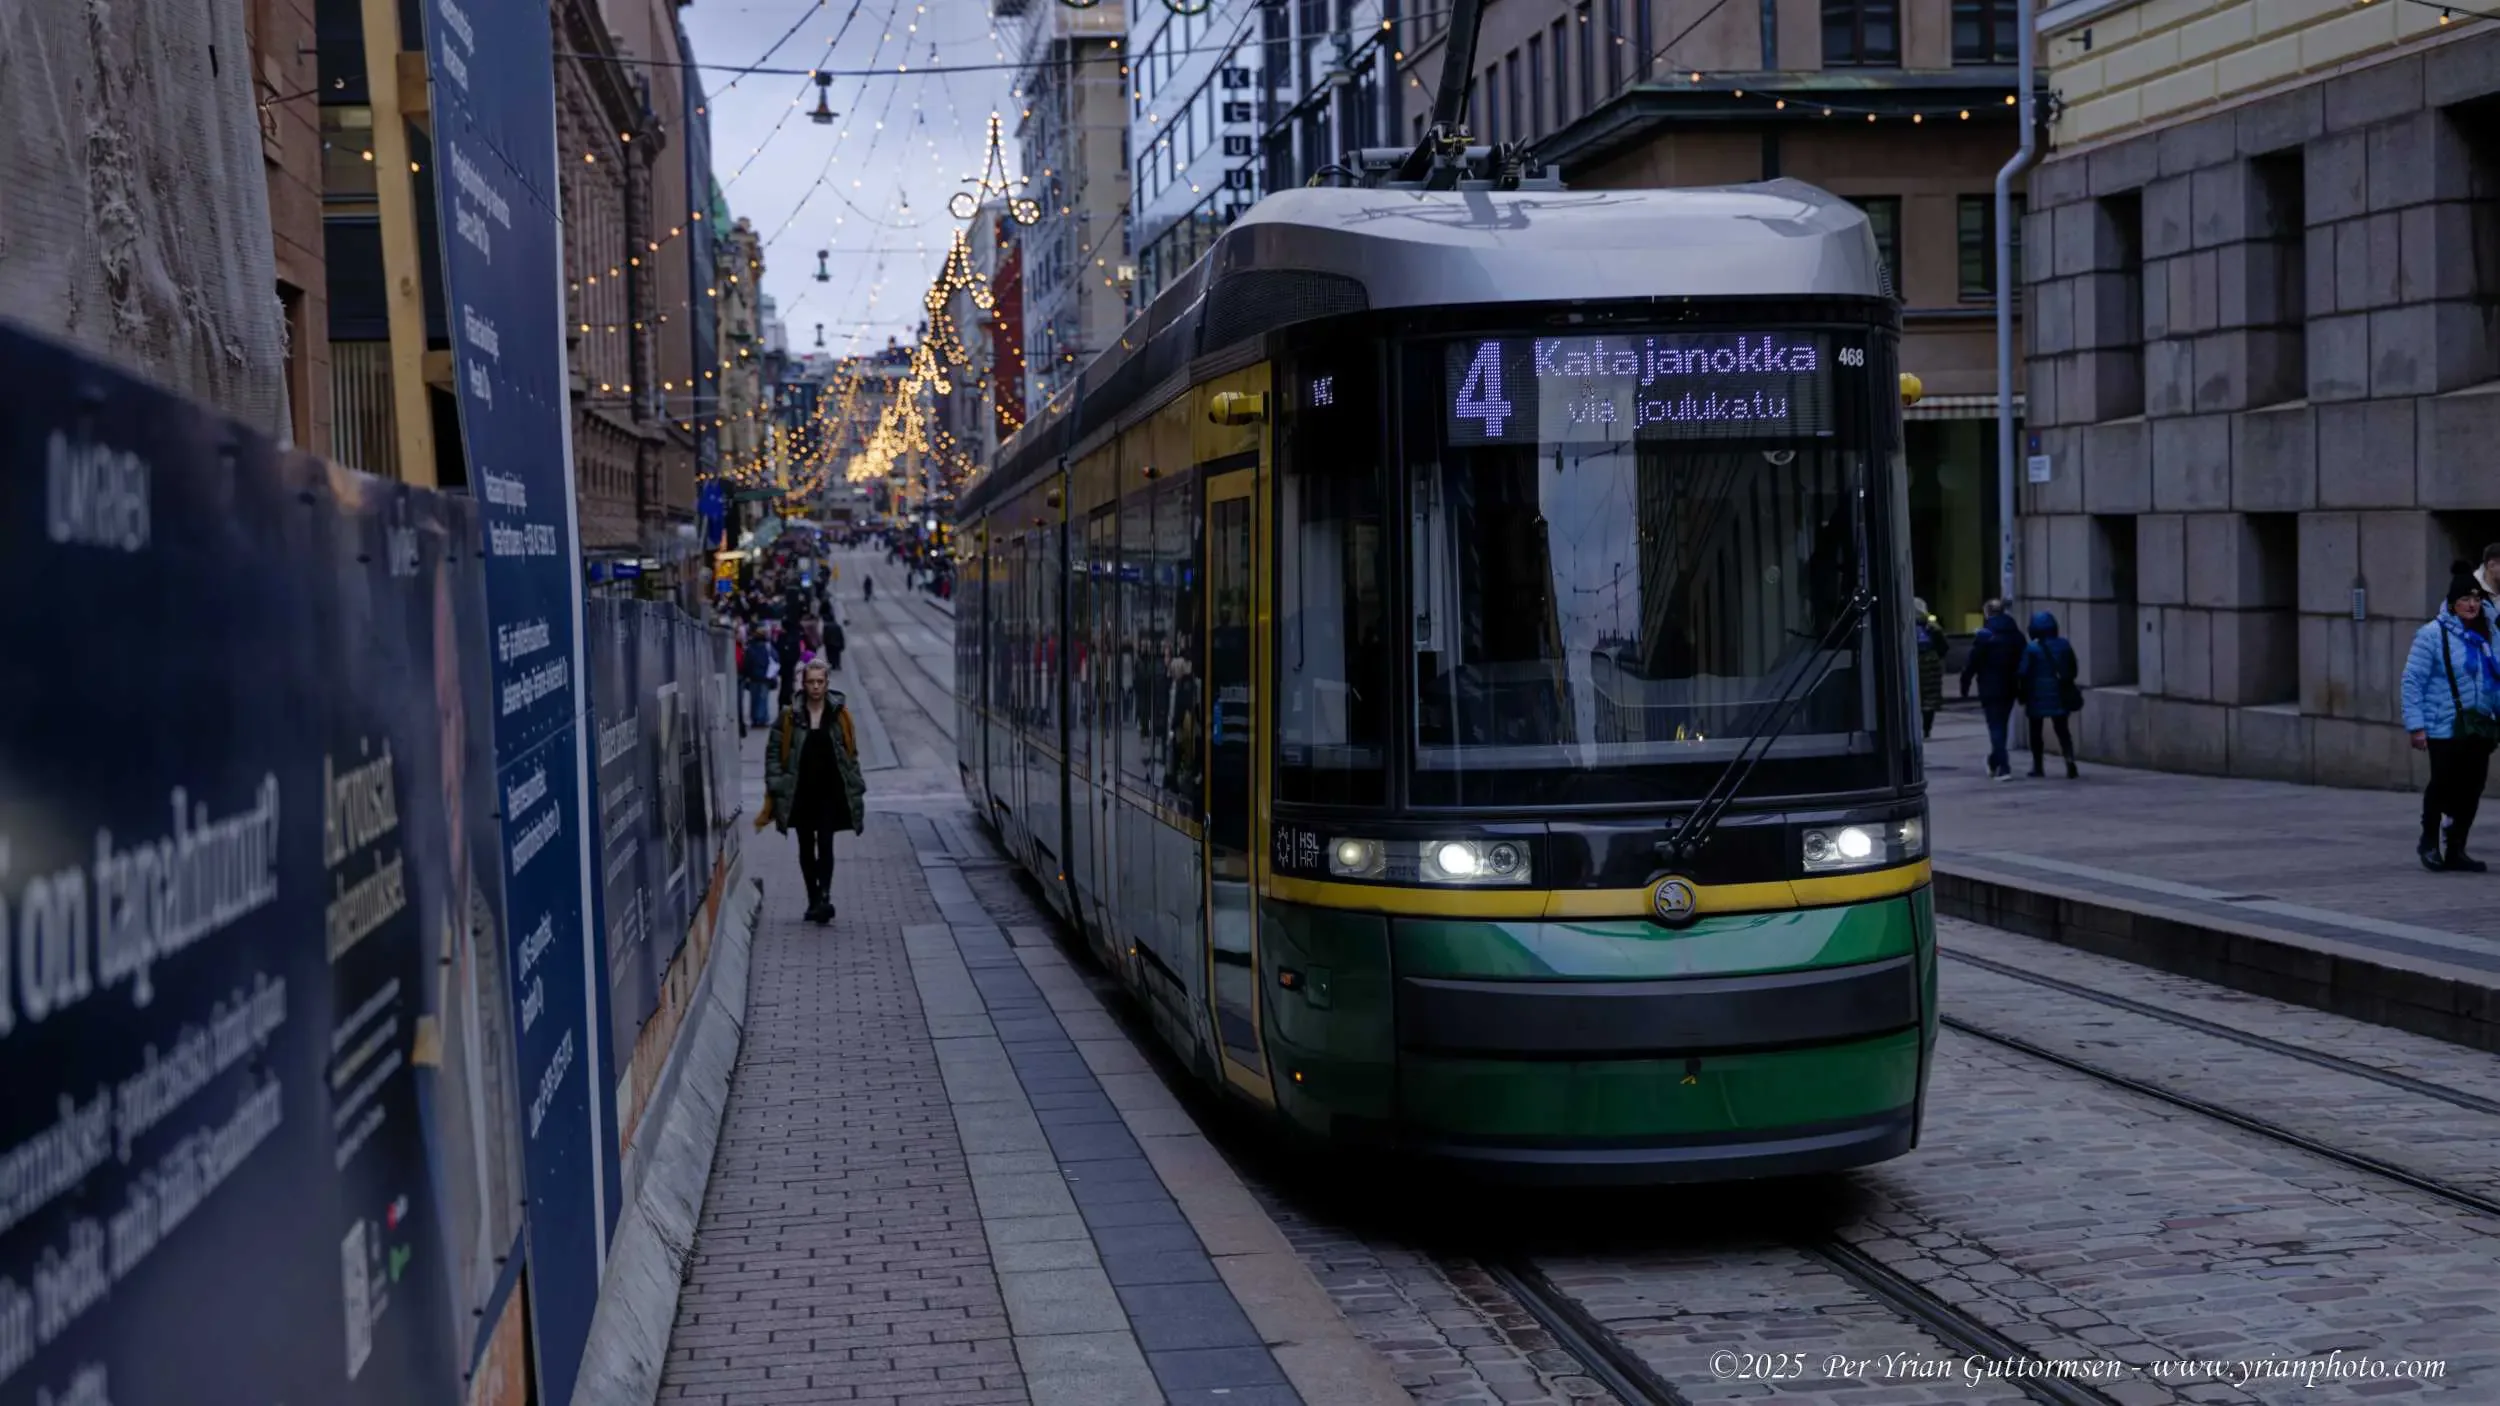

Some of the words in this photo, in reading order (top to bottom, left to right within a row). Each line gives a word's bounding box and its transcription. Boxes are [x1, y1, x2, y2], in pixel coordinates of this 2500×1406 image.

[1838, 347, 1864, 367] 468
[1455, 341, 1512, 438] 4
[1534, 335, 1816, 388] Katajanokka
[1567, 394, 1618, 425] via
[1632, 391, 1788, 431] joulukatu
[1299, 831, 1319, 850] HSL
[1299, 849, 1320, 868] HRT
